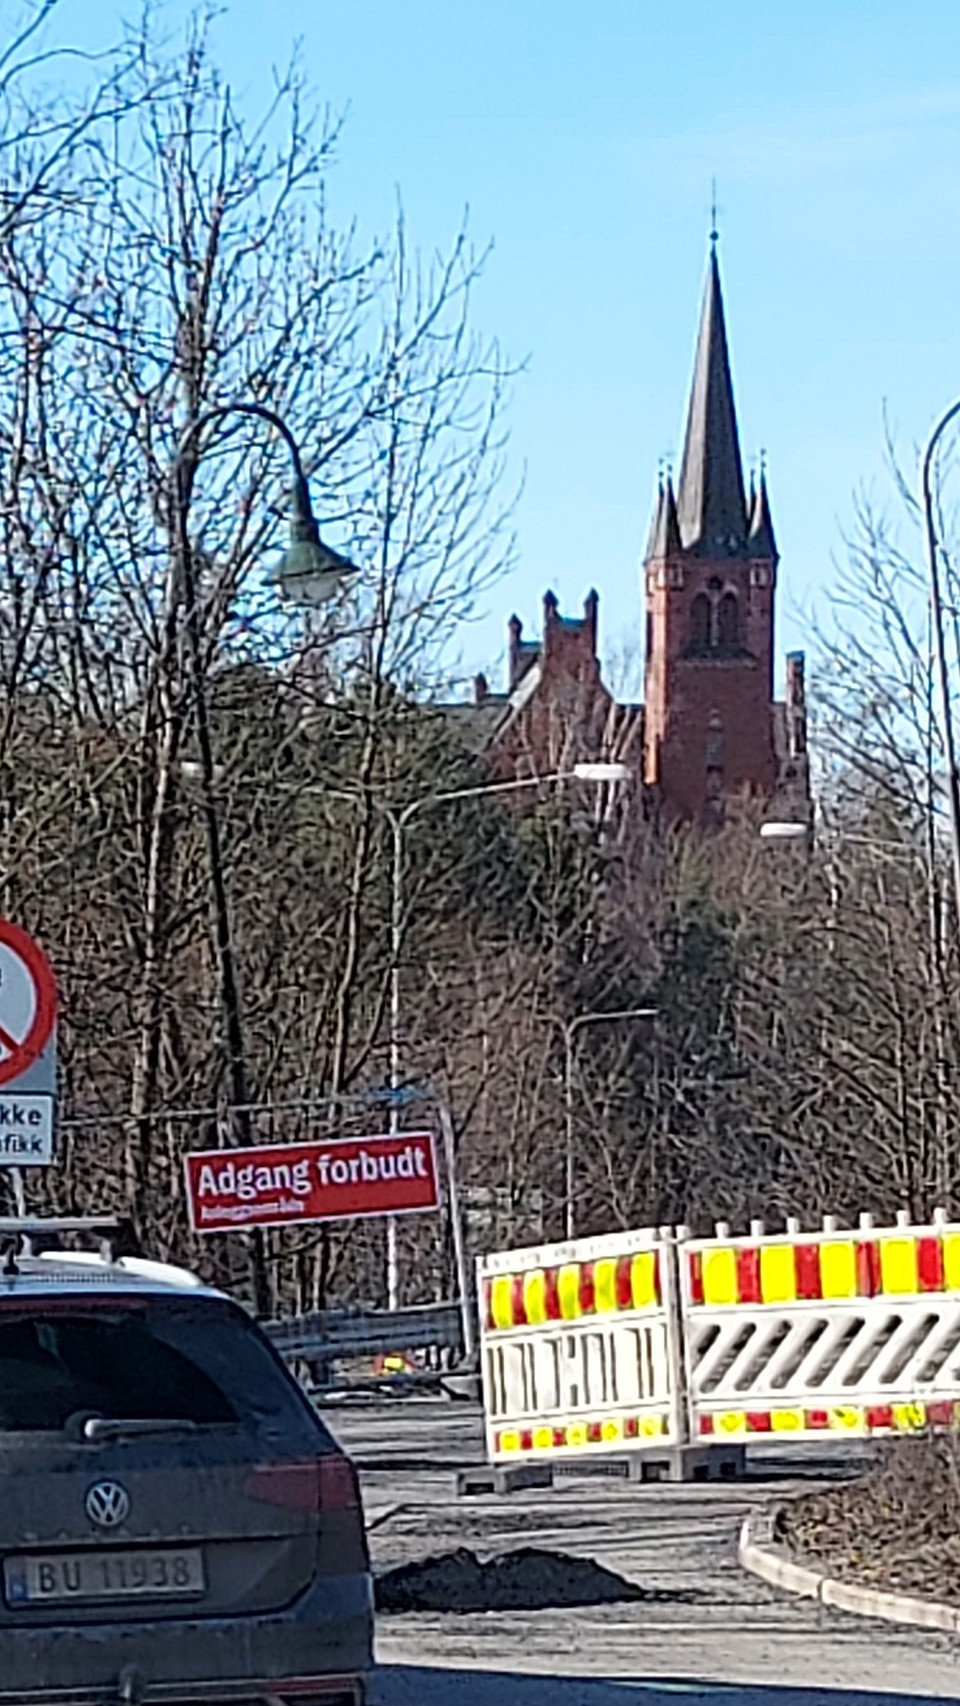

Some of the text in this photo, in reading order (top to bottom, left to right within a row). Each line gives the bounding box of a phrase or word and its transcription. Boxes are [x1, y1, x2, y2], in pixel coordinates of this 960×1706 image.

[197, 1147, 429, 1199] Adgang forbudt
[40, 1556, 189, 1592] BU 11938
